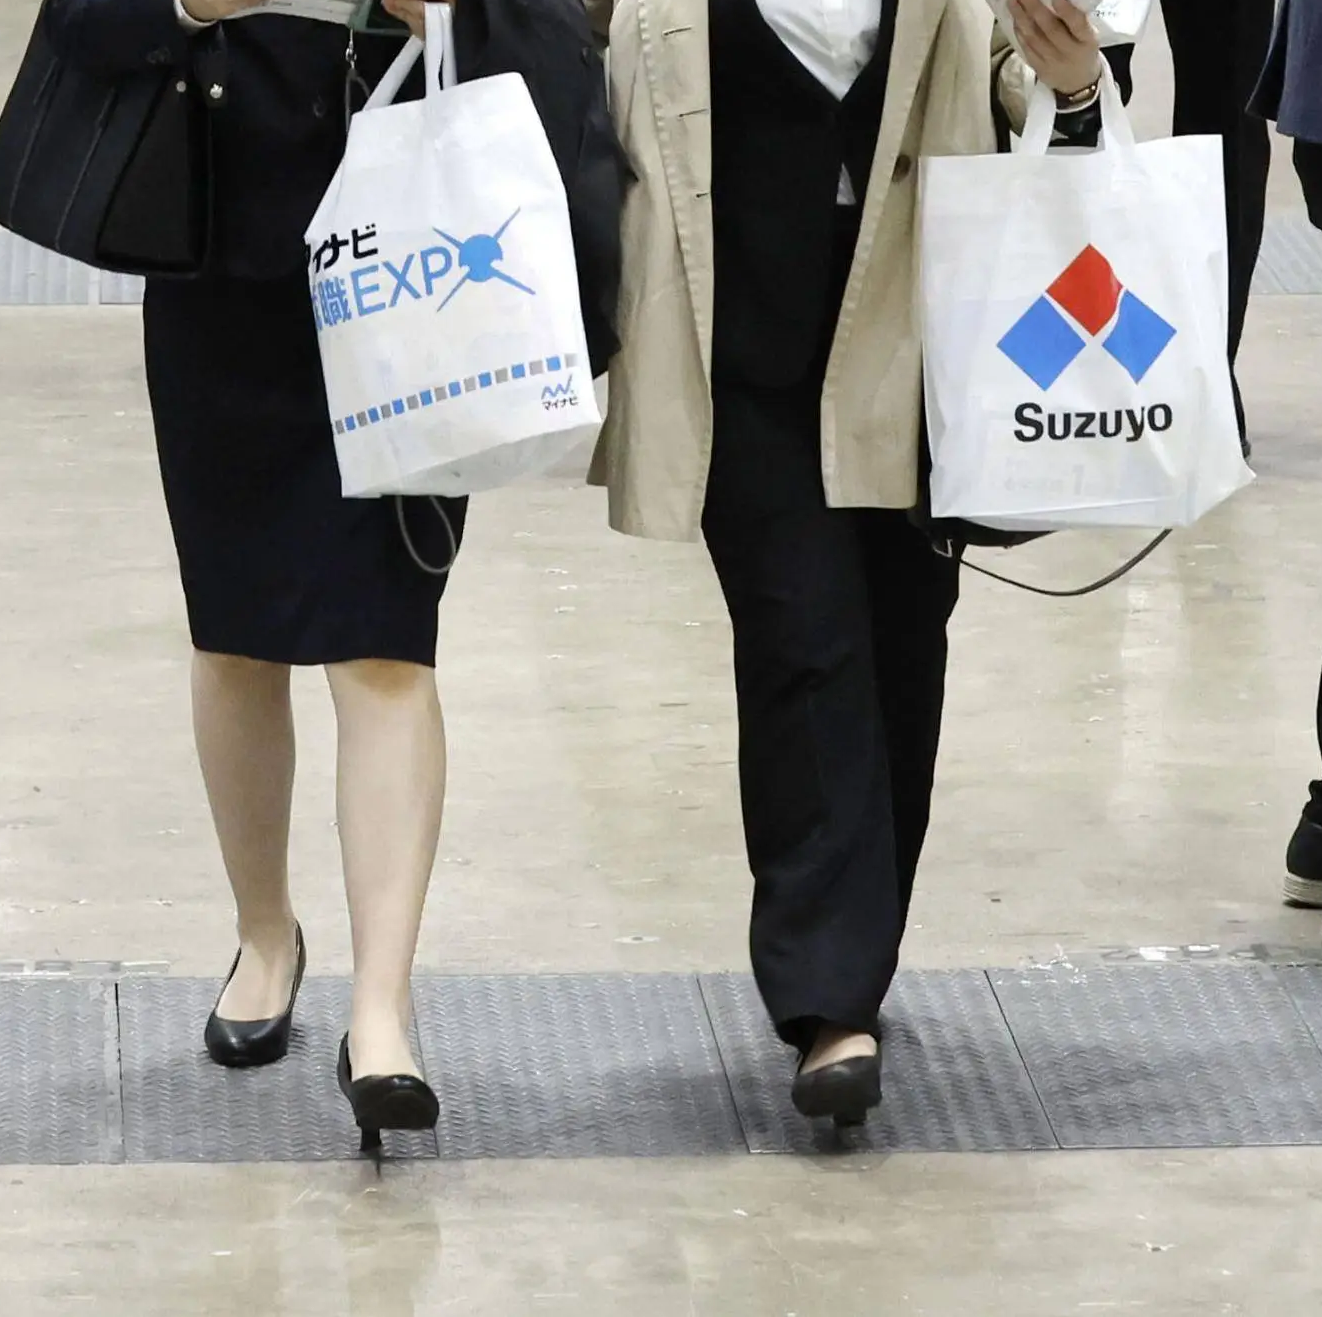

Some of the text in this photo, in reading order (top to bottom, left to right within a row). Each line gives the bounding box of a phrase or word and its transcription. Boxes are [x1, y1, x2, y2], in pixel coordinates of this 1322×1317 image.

[304, 222, 379, 274] イナビ
[542, 396, 580, 411] マイナビ
[1013, 400, 1174, 444] Suzuyo
